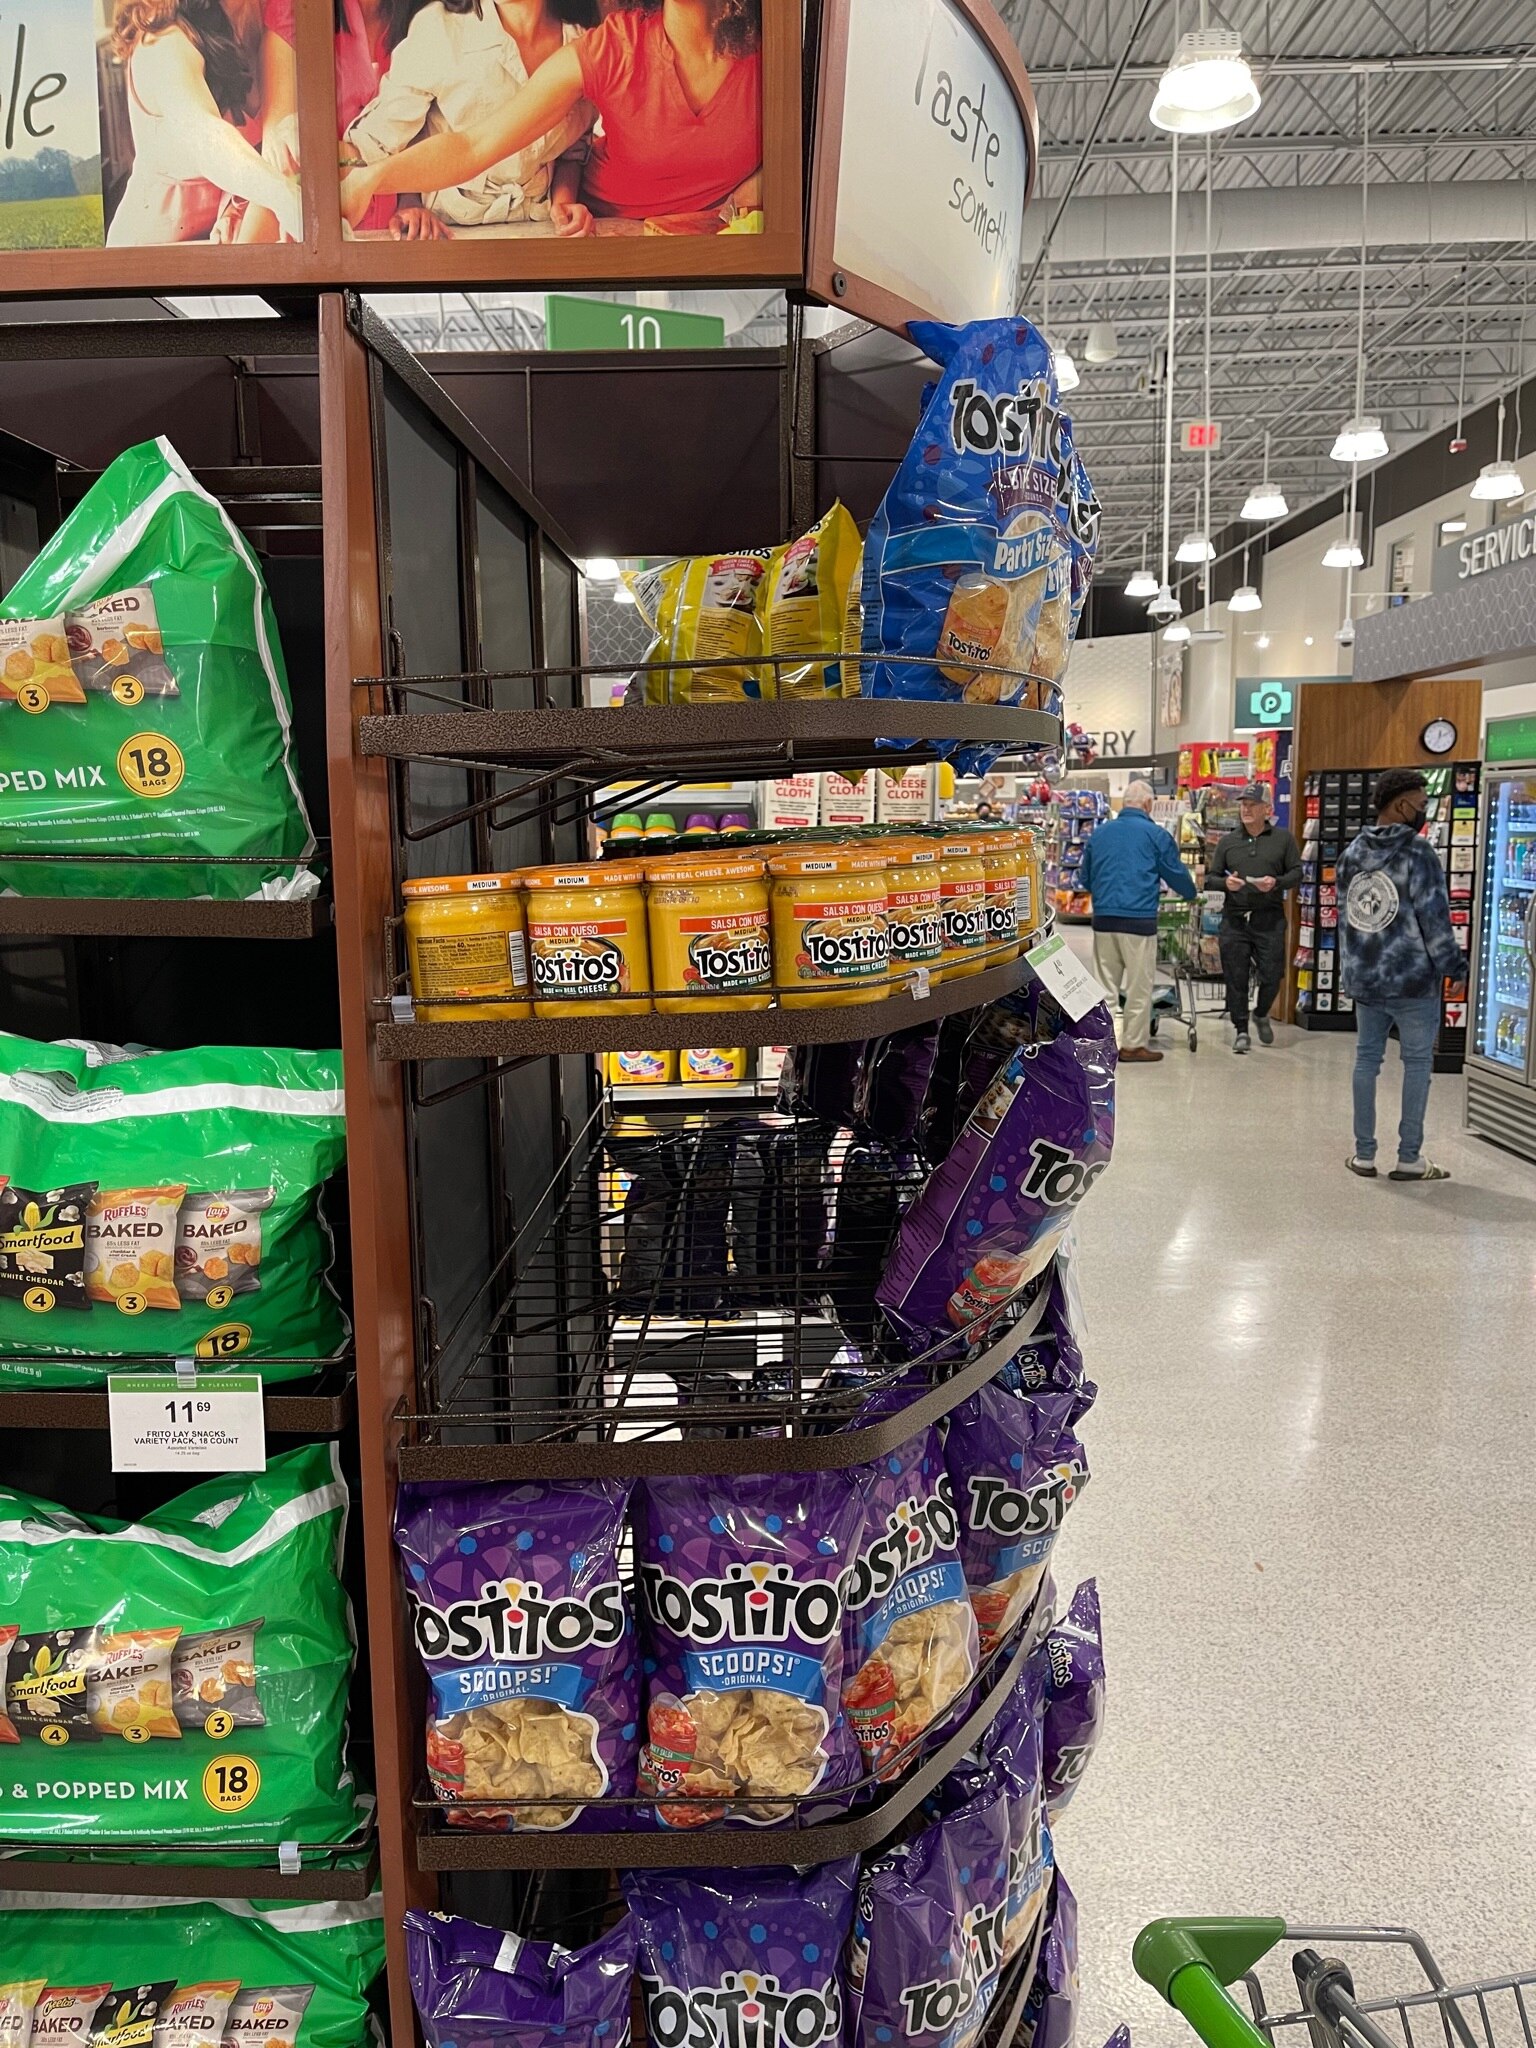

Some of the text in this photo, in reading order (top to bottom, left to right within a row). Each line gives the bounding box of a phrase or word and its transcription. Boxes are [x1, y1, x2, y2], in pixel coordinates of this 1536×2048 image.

[0, 24, 67, 149] le
[620, 313, 661, 350] 10
[1188, 426, 1217, 447] EXT
[1032, 471, 1058, 498] SIZE
[993, 538, 1034, 572] Party
[1458, 515, 1536, 580] SERVIC
[26, 689, 40, 707] 3
[121, 682, 135, 699] 3
[128, 748, 171, 779] 18
[55, 765, 107, 789] MIX
[142, 779, 167, 788] BAGS
[774, 777, 815, 788] CHEESE
[826, 774, 869, 785] CHEE
[776, 787, 812, 798] CLOTH
[829, 785, 865, 795] CLOTH
[887, 789, 924, 800] CLOTH
[805, 860, 868, 870] MEDIUM MADE
[558, 877, 585, 885] MEDIUM
[660, 872, 675, 880] WITH
[676, 872, 693, 880] REAL
[472, 881, 497, 889] MEDIUM
[955, 885, 974, 894] SALSA
[994, 882, 1010, 891] SALSA
[895, 892, 931, 904] SALSA CON
[823, 902, 883, 917] SALSA CON QUES
[916, 903, 935, 911] MEDIUM
[711, 913, 767, 929] SALSA CON QUES
[846, 915, 871, 924] MEDIUM
[534, 925, 598, 937] SALSA CON QUESO
[734, 927, 757, 935] MEDIUM
[578, 983, 608, 994] CHEESE
[104, 1205, 147, 1222] RUFFLES
[88, 1223, 163, 1238] BAKED
[183, 1219, 247, 1238] BAKED
[0, 1231, 75, 1249] Smartfood
[0, 1272, 64, 1287] WHITE CHEDDAR
[32, 1293, 46, 1308] 4
[125, 1297, 137, 1310] 3
[215, 1290, 225, 1305] 3
[207, 1331, 240, 1356] 18
[165, 1401, 211, 1423] 11 69
[134, 1437, 239, 1446] VARIETY PACK, 18 COUNT
[147, 1430, 226, 1438] FRITO LAY SNACKS
[896, 1594, 934, 1614] ORIGINAL
[106, 1648, 143, 1665] RUFFLES
[177, 1640, 241, 1663] BAKED
[699, 1652, 793, 1677] SCOOPS!
[87, 1663, 159, 1683] BAKED
[724, 1674, 767, 1686] ORIGINAL
[8, 1676, 78, 1698] Smartfood
[482, 1687, 527, 1702] ORIGINAL
[39, 1717, 73, 1725] CHEDDAR
[213, 1716, 225, 1733] 3
[49, 1729, 62, 1742] 4
[130, 1728, 141, 1739] 3
[215, 1766, 249, 1793] 18
[11, 1779, 189, 1799] & POPPED MIX
[43, 1998, 75, 2016] Cheetos
[172, 1999, 205, 2015] RUFFLES
[32, 2017, 83, 2033] BAKED
[155, 2016, 214, 2030] BAKED
[230, 2019, 288, 2030] BAKED
[96, 2025, 150, 2048] martfood
